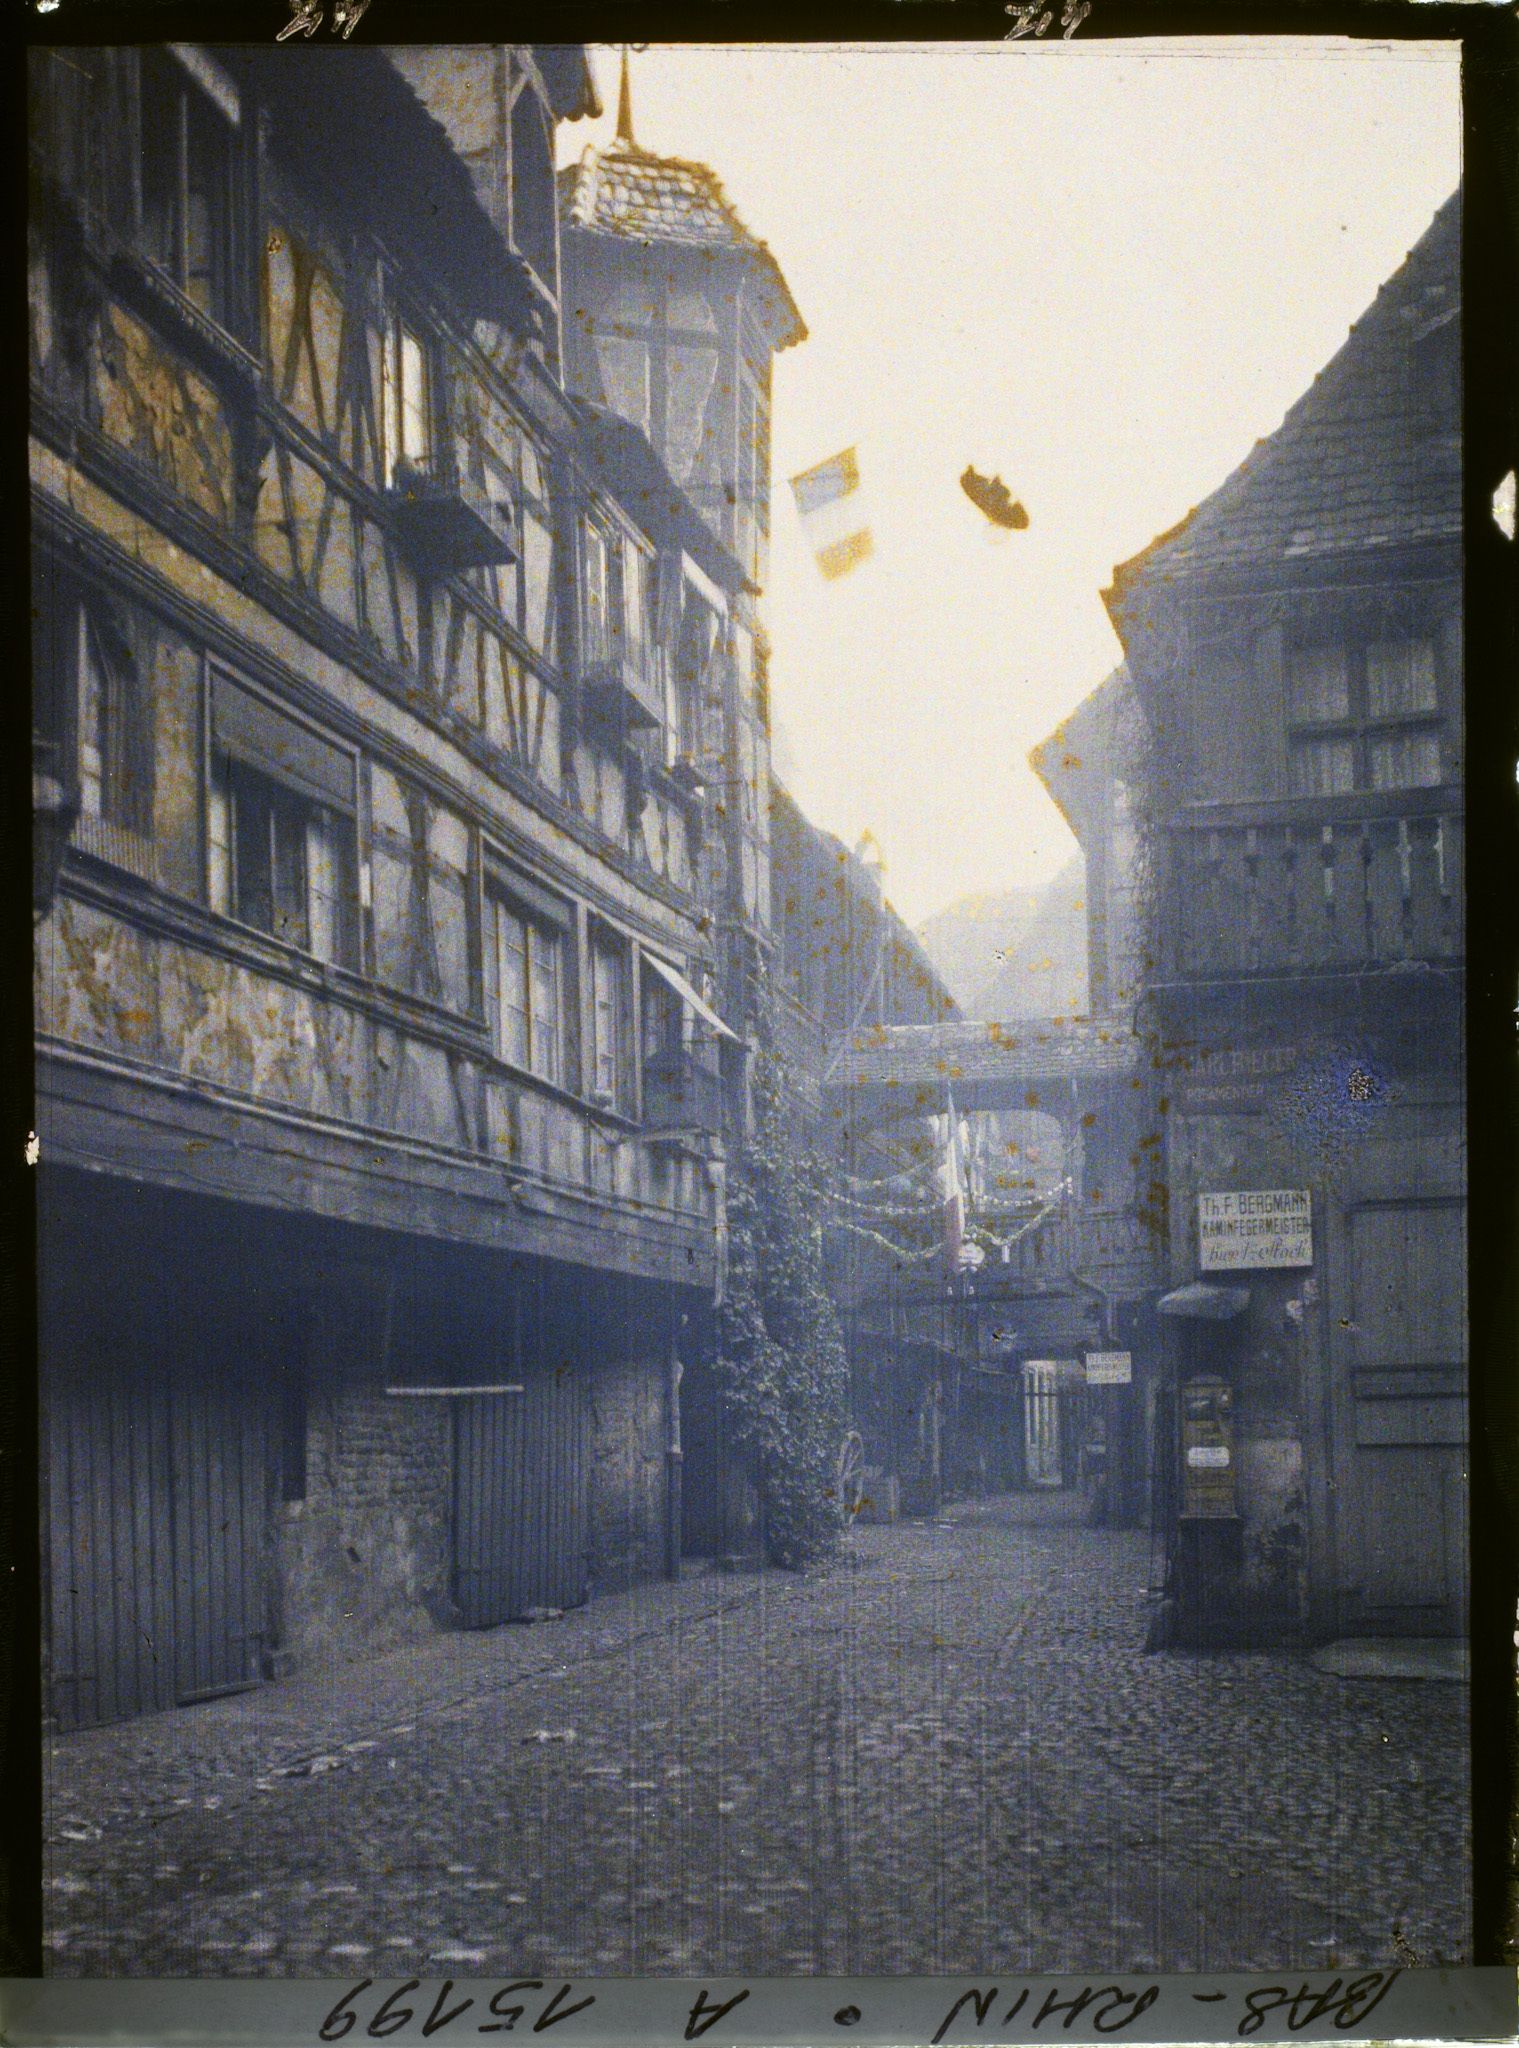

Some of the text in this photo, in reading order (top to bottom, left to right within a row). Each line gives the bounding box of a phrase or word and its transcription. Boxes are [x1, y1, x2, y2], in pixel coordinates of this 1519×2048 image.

[1238, 1193, 1308, 1215] BERGMANN
[318, 1979, 596, 2042] 15199
[685, 1988, 751, 2041] A
